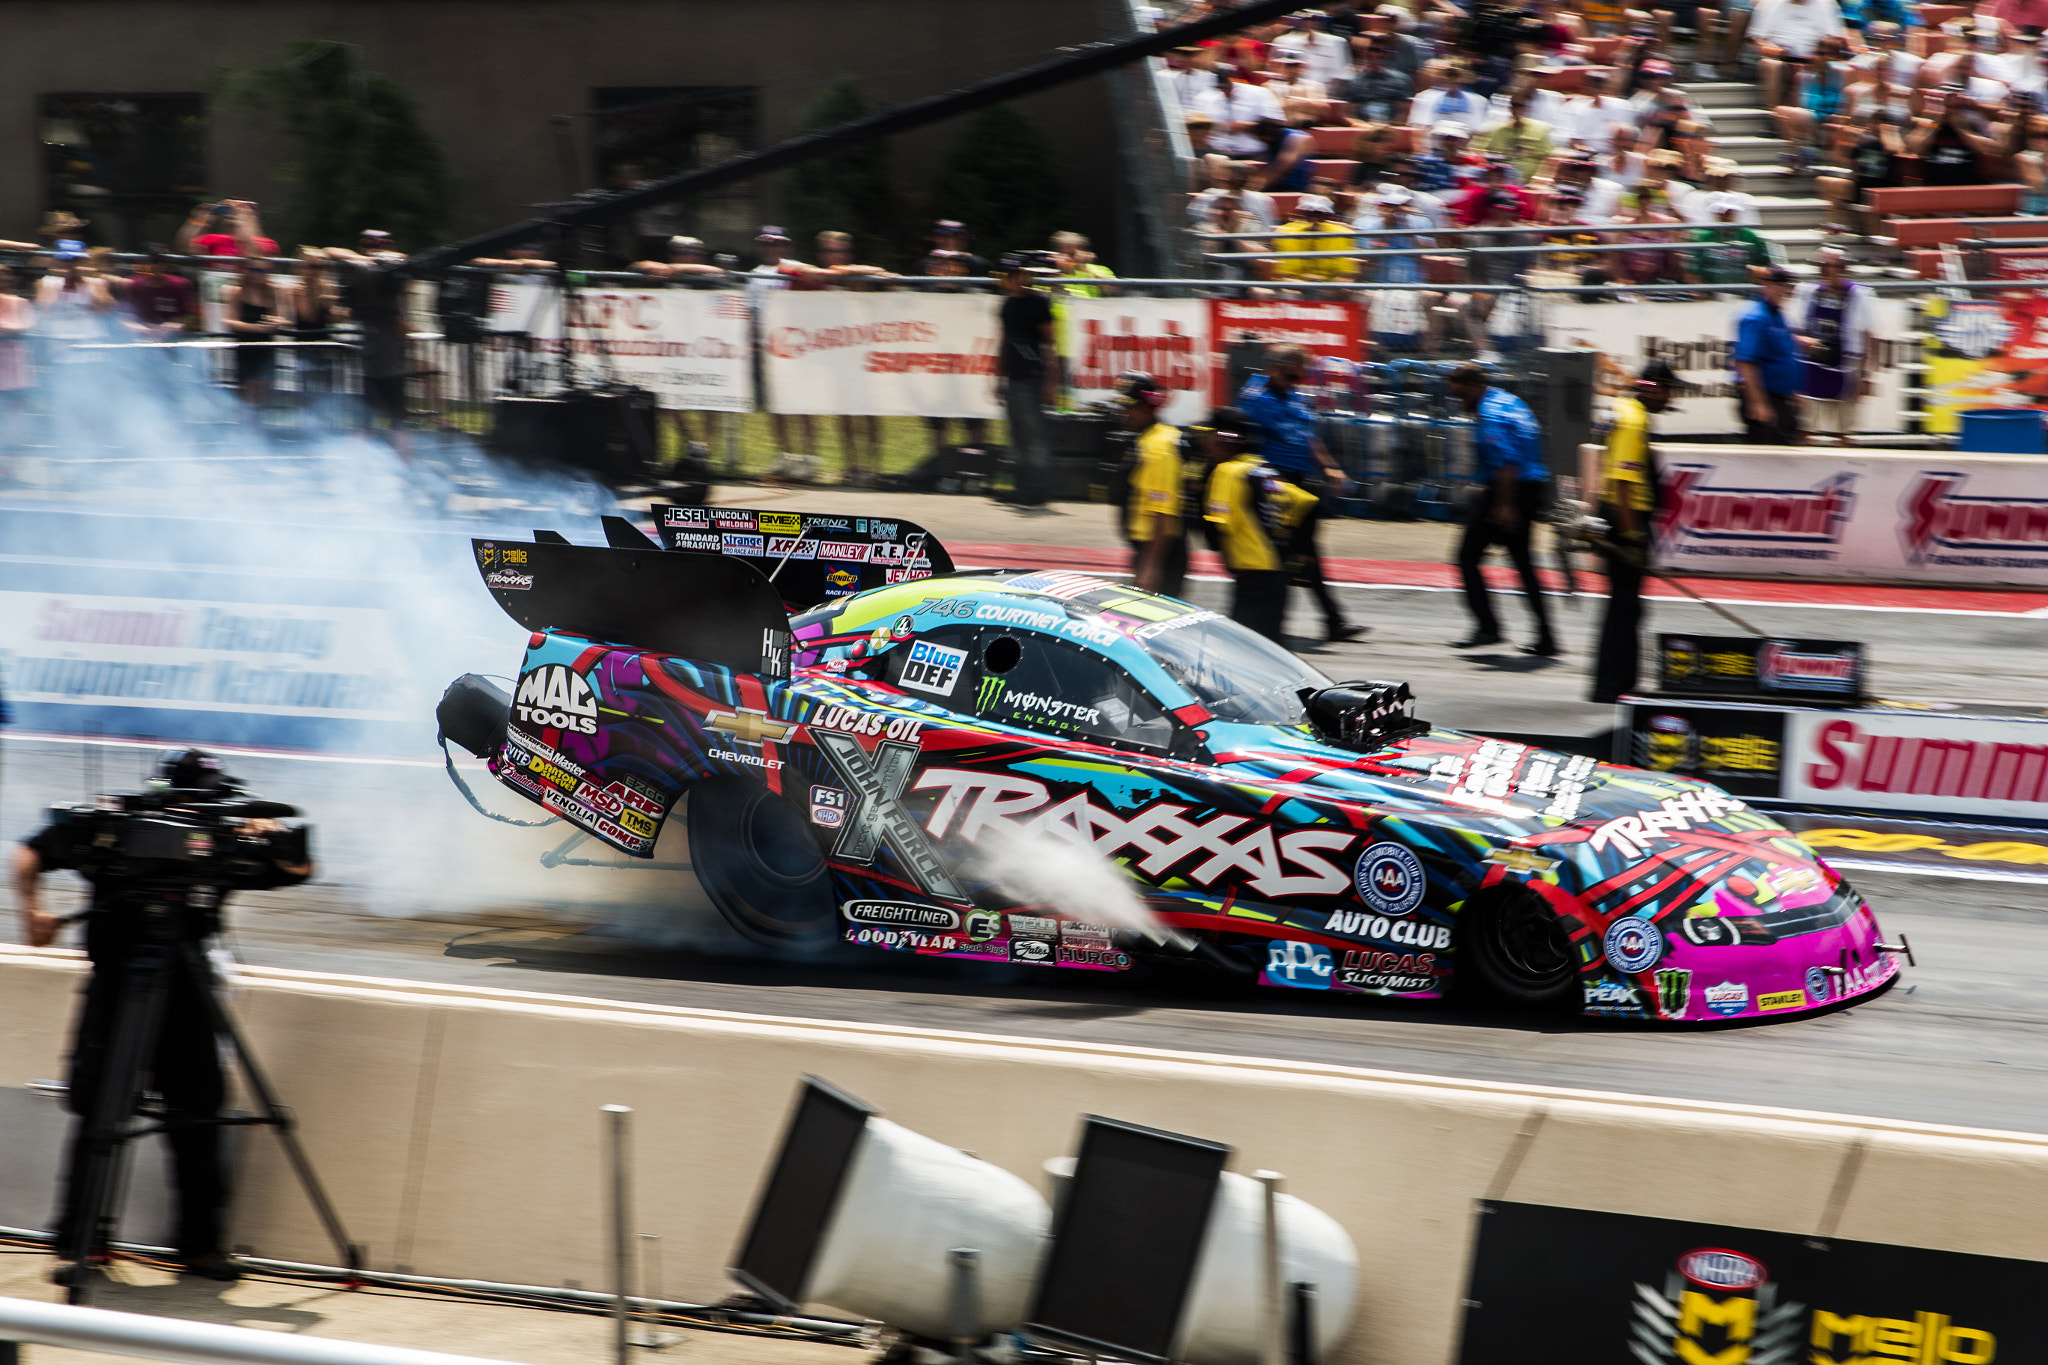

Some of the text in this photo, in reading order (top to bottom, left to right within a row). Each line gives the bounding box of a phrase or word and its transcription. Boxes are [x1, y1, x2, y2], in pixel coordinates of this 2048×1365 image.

[664, 507, 709, 522] JESEL
[710, 510, 749, 521] LINCOLN
[719, 519, 754, 529] WELDERS
[760, 514, 791, 525] BME
[806, 517, 849, 527] TREND
[870, 519, 899, 534] Flow
[675, 532, 720, 543] STANDARD
[675, 541, 721, 551] ABRASIVES
[769, 539, 806, 553] XRP
[723, 547, 734, 555] PRO
[820, 544, 861, 559] MANLEY
[486, 575, 535, 585] TRAXXAS
[826, 574, 858, 584] SUNOCO
[914, 598, 1123, 648] 746 COURTNEY FORCE
[911, 642, 961, 669] Blue
[903, 660, 954, 689] DEF
[516, 665, 598, 718] MAC
[516, 704, 597, 735] TOOLS
[810, 704, 924, 743] LUCAS OIL
[1013, 711, 1081, 732] ENERGY
[707, 748, 786, 771] CHEVROLET
[552, 752, 604, 788] Mastercam
[541, 770, 575, 792] SLEEVES
[546, 789, 594, 823] VENOLIA
[578, 784, 622, 813] MSD
[605, 781, 665, 816] ARP
[814, 788, 845, 807] FS1
[626, 811, 652, 832] TMS
[815, 812, 841, 823] NHRA
[836, 747, 891, 806] JOHN
[883, 807, 947, 885] FORCE
[597, 820, 640, 846] COMP
[624, 821, 650, 836] TITANIUM
[910, 766, 1360, 899] TRAXXAS
[1375, 868, 1406, 888] AAA
[854, 904, 949, 925] FREIGHTLINER
[1009, 915, 1057, 931] WELD
[1324, 909, 1451, 949] AUTO CLUB
[845, 929, 957, 950] GOODYEAR
[1065, 937, 1108, 948] SIMPSON
[1059, 947, 1131, 967] HURCO
[1342, 949, 1437, 974] LUCAS
[1584, 988, 1642, 1004] PEAK
[1760, 993, 1803, 1007] STANLEY
